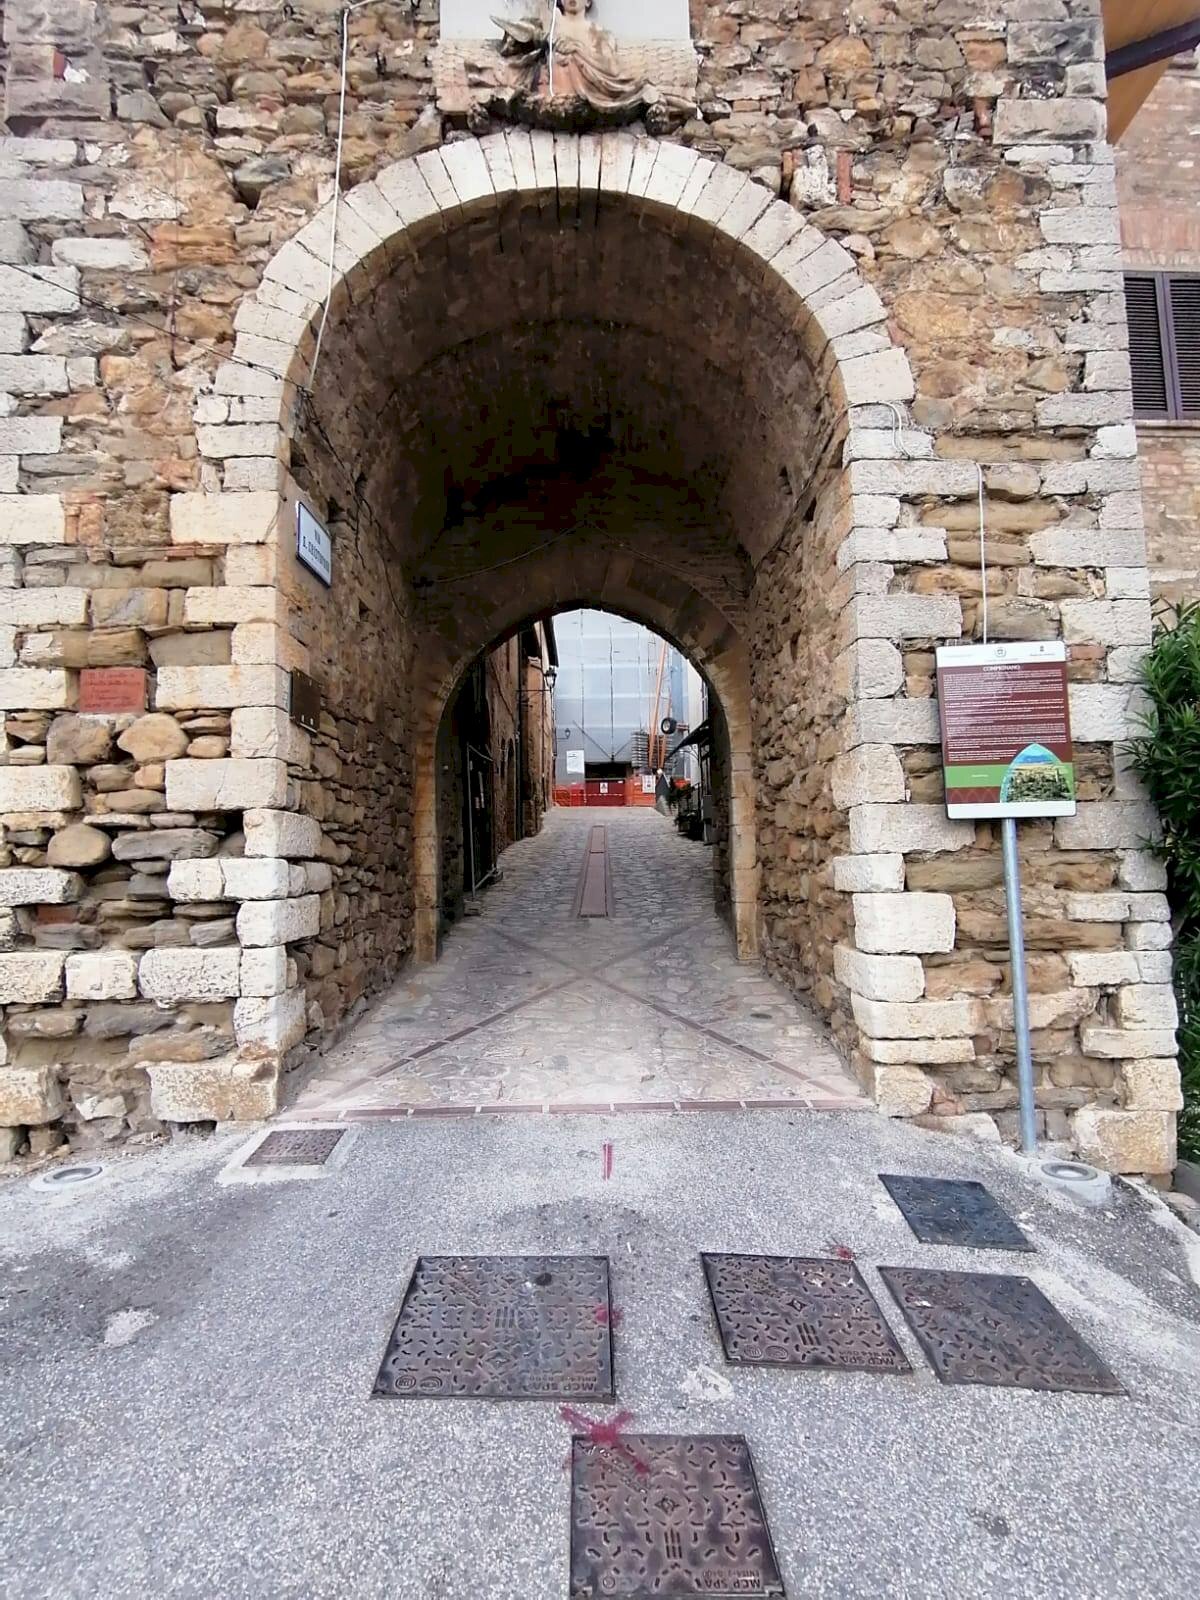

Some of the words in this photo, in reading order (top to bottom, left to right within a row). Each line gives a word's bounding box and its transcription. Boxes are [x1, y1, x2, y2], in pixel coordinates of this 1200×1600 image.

[868, 1357, 894, 1366] MCP
[563, 1383, 594, 1391] MCP
[704, 1578, 728, 1589] SPA
[732, 1578, 760, 1589] MCP
